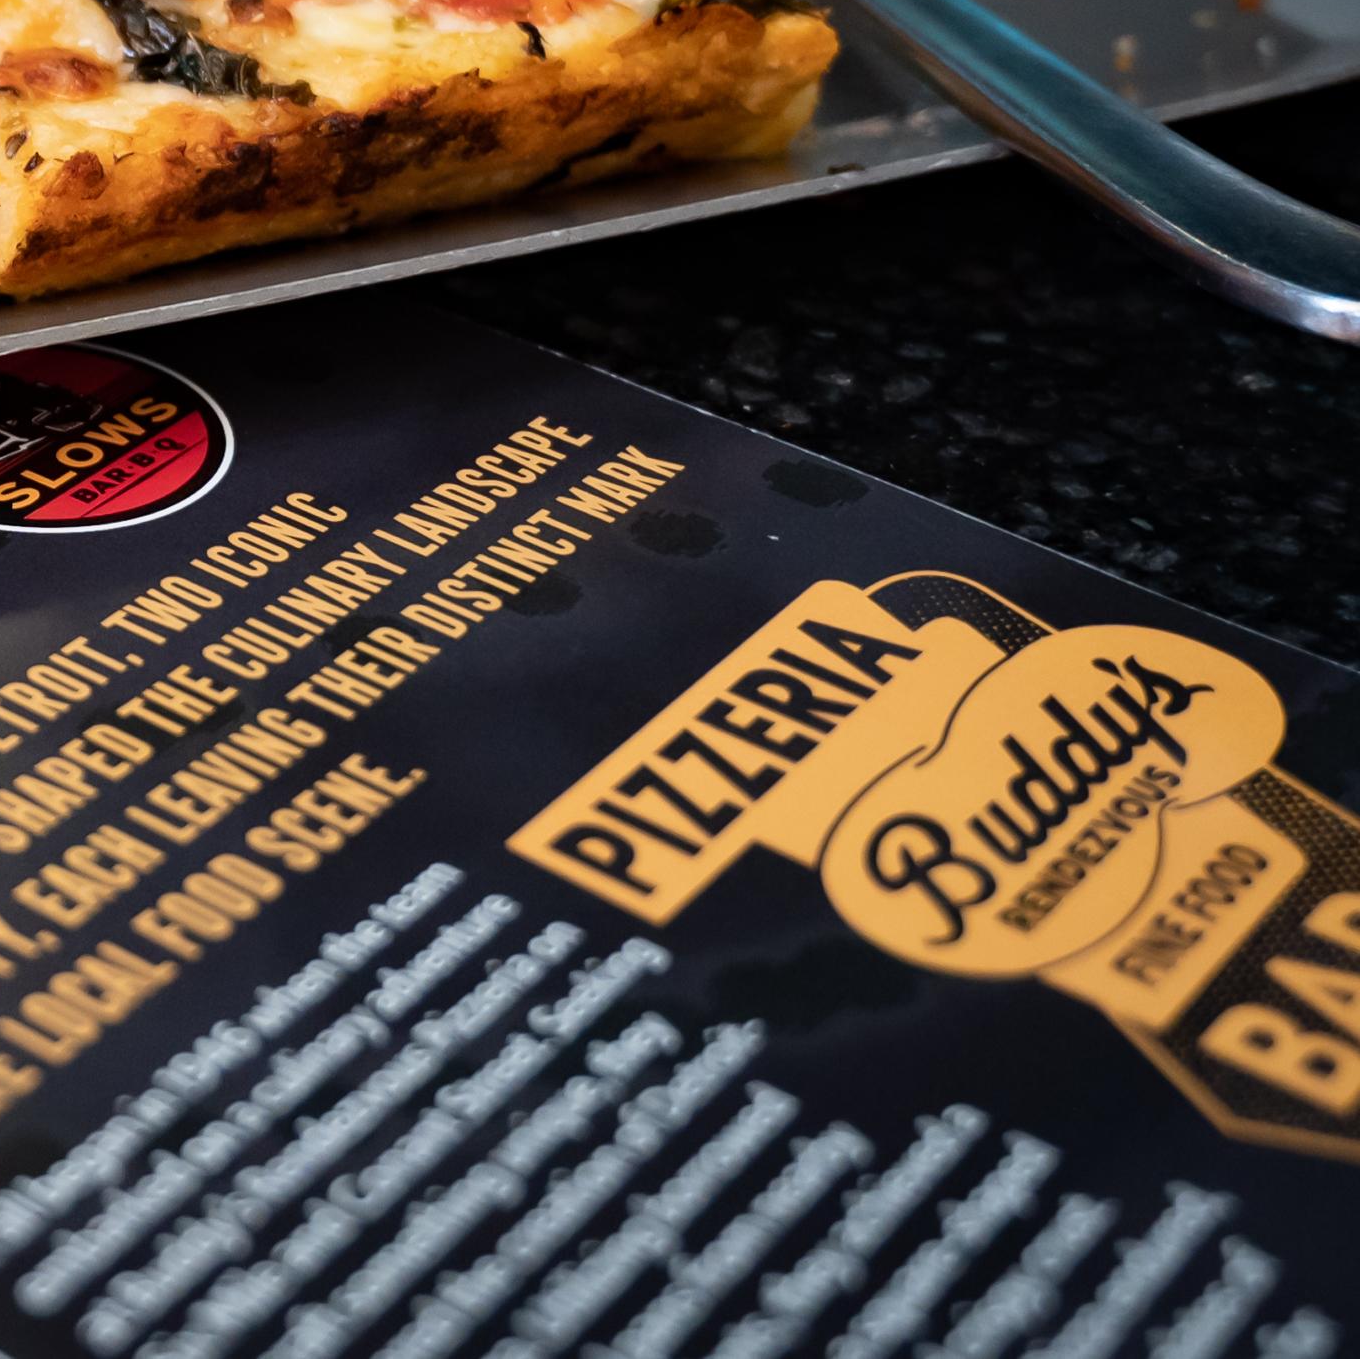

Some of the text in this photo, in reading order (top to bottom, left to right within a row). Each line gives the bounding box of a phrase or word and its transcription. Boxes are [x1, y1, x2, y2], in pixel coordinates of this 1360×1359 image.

[12, 824, 166, 928] EACH
[125, 708, 328, 846] LEAVING
[286, 626, 442, 722] THEIR
[400, 508, 592, 640] DISTINCT
[556, 445, 685, 525] MARK
[100, 575, 223, 645] TWO
[190, 491, 349, 589] ICONIC
[116, 665, 239, 739] THE
[202, 541, 407, 682] CULINARY
[373, 415, 594, 558] LANDSCAPE
[130, 853, 284, 962] FOOD
[246, 754, 428, 873] SCENE.
[548, 620, 922, 896] PIZZERIA
[862, 654, 1215, 947] Buddy's
[996, 763, 1182, 933] RENDEZVOUS
[1111, 843, 1268, 987] FINE FOOD
